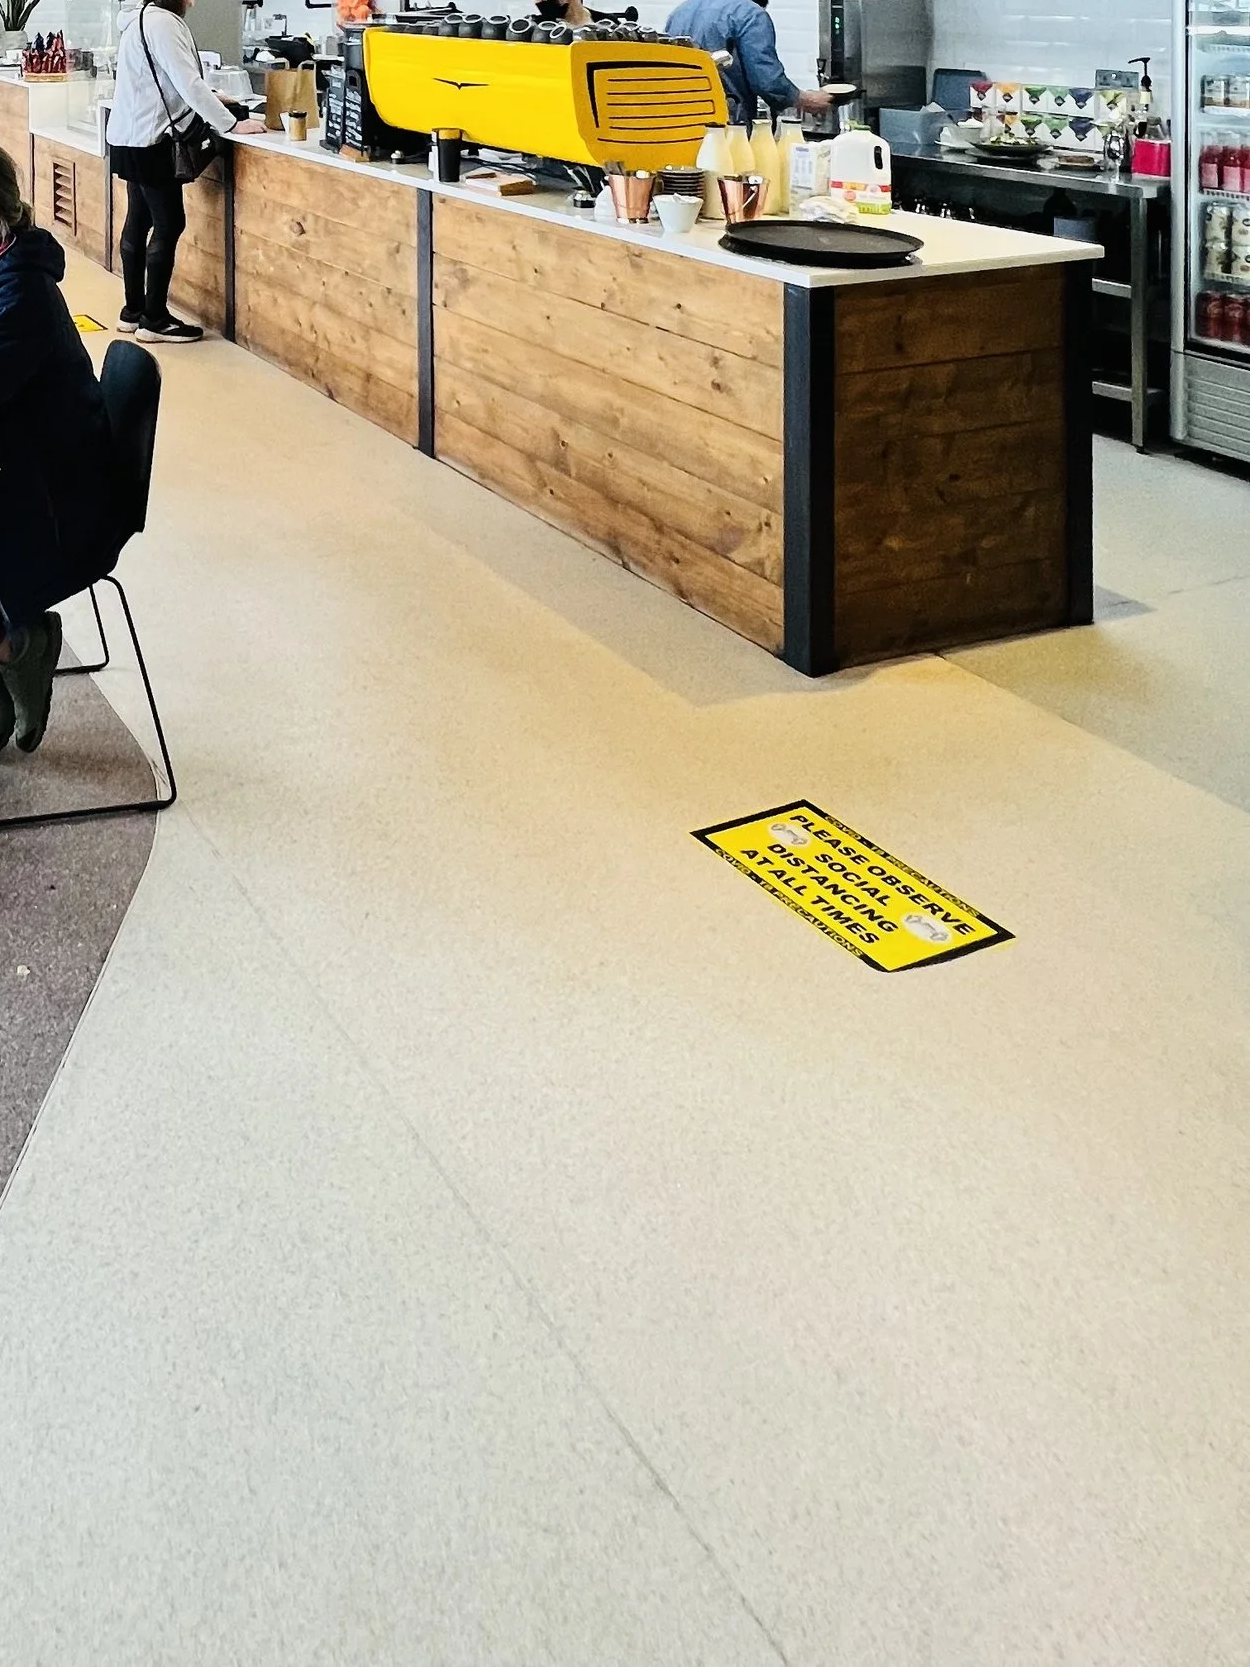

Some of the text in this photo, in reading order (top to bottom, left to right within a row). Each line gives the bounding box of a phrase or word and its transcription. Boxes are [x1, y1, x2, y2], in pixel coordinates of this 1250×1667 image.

[740, 849, 881, 946] AT ALL TIMES
[767, 843, 899, 934] DISTANCING
[789, 814, 976, 936] PLEASE OBSERVE
[814, 852, 891, 907] SOCIAL
